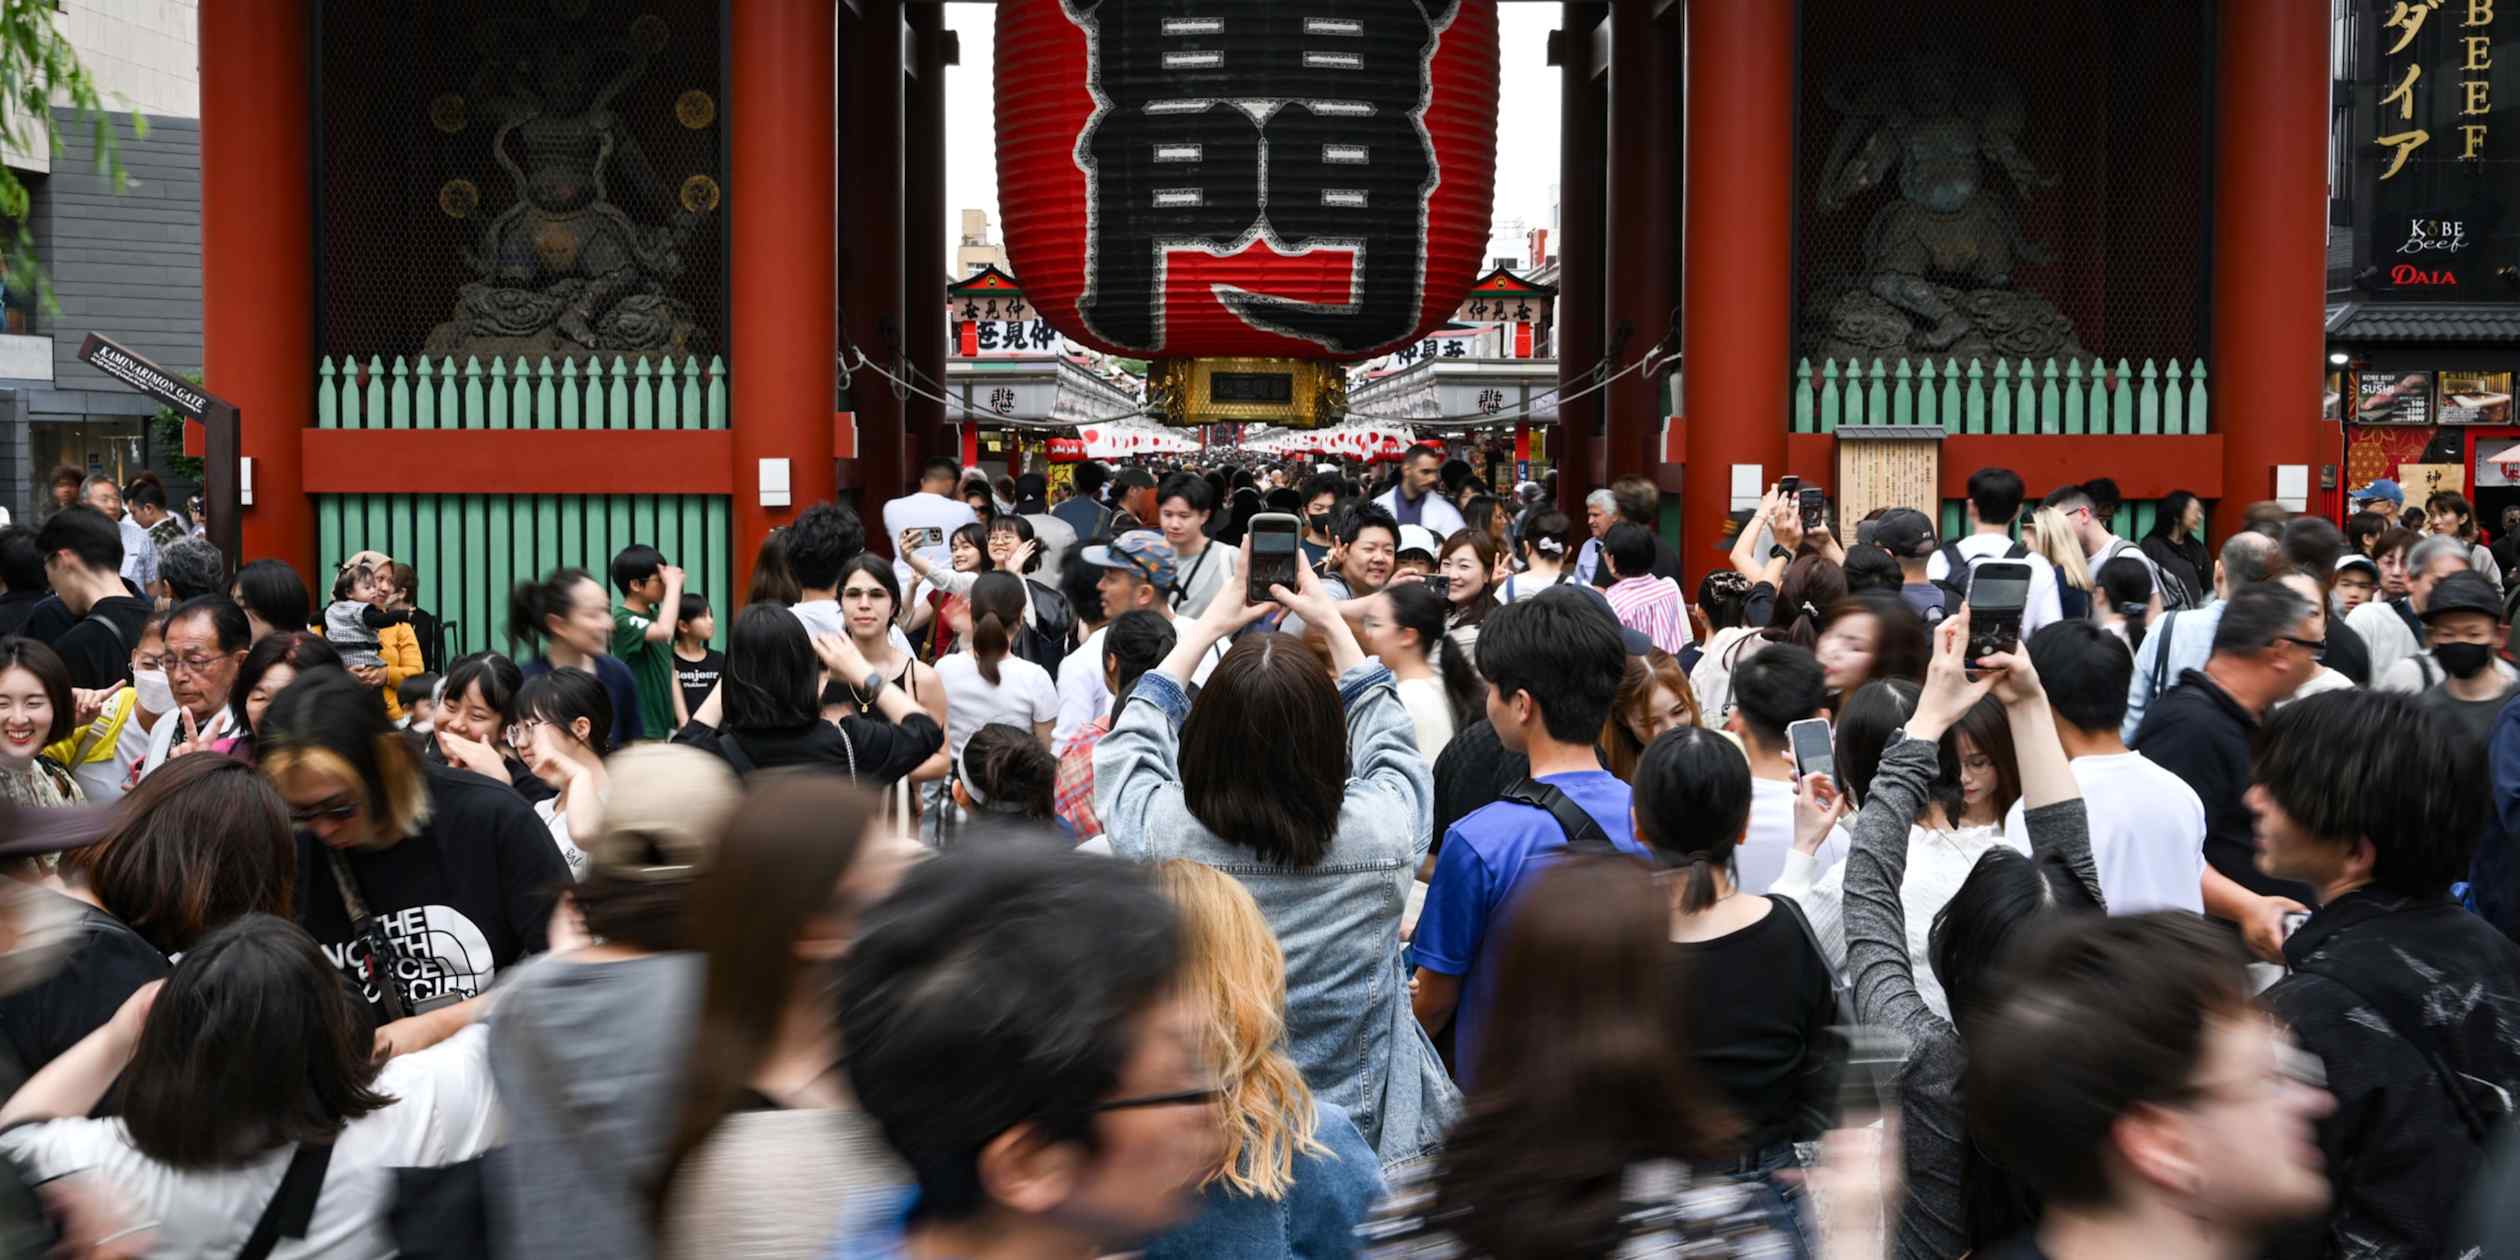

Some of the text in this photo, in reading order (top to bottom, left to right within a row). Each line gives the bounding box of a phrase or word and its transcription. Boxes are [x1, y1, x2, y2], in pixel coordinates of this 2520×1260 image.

[2462, 0, 2495, 160] BEEF
[2396, 232, 2470, 254] Beef
[99, 345, 179, 392] KAMINARIMON
[176, 385, 208, 409] GATE
[2361, 384, 2395, 394] SUSHI
